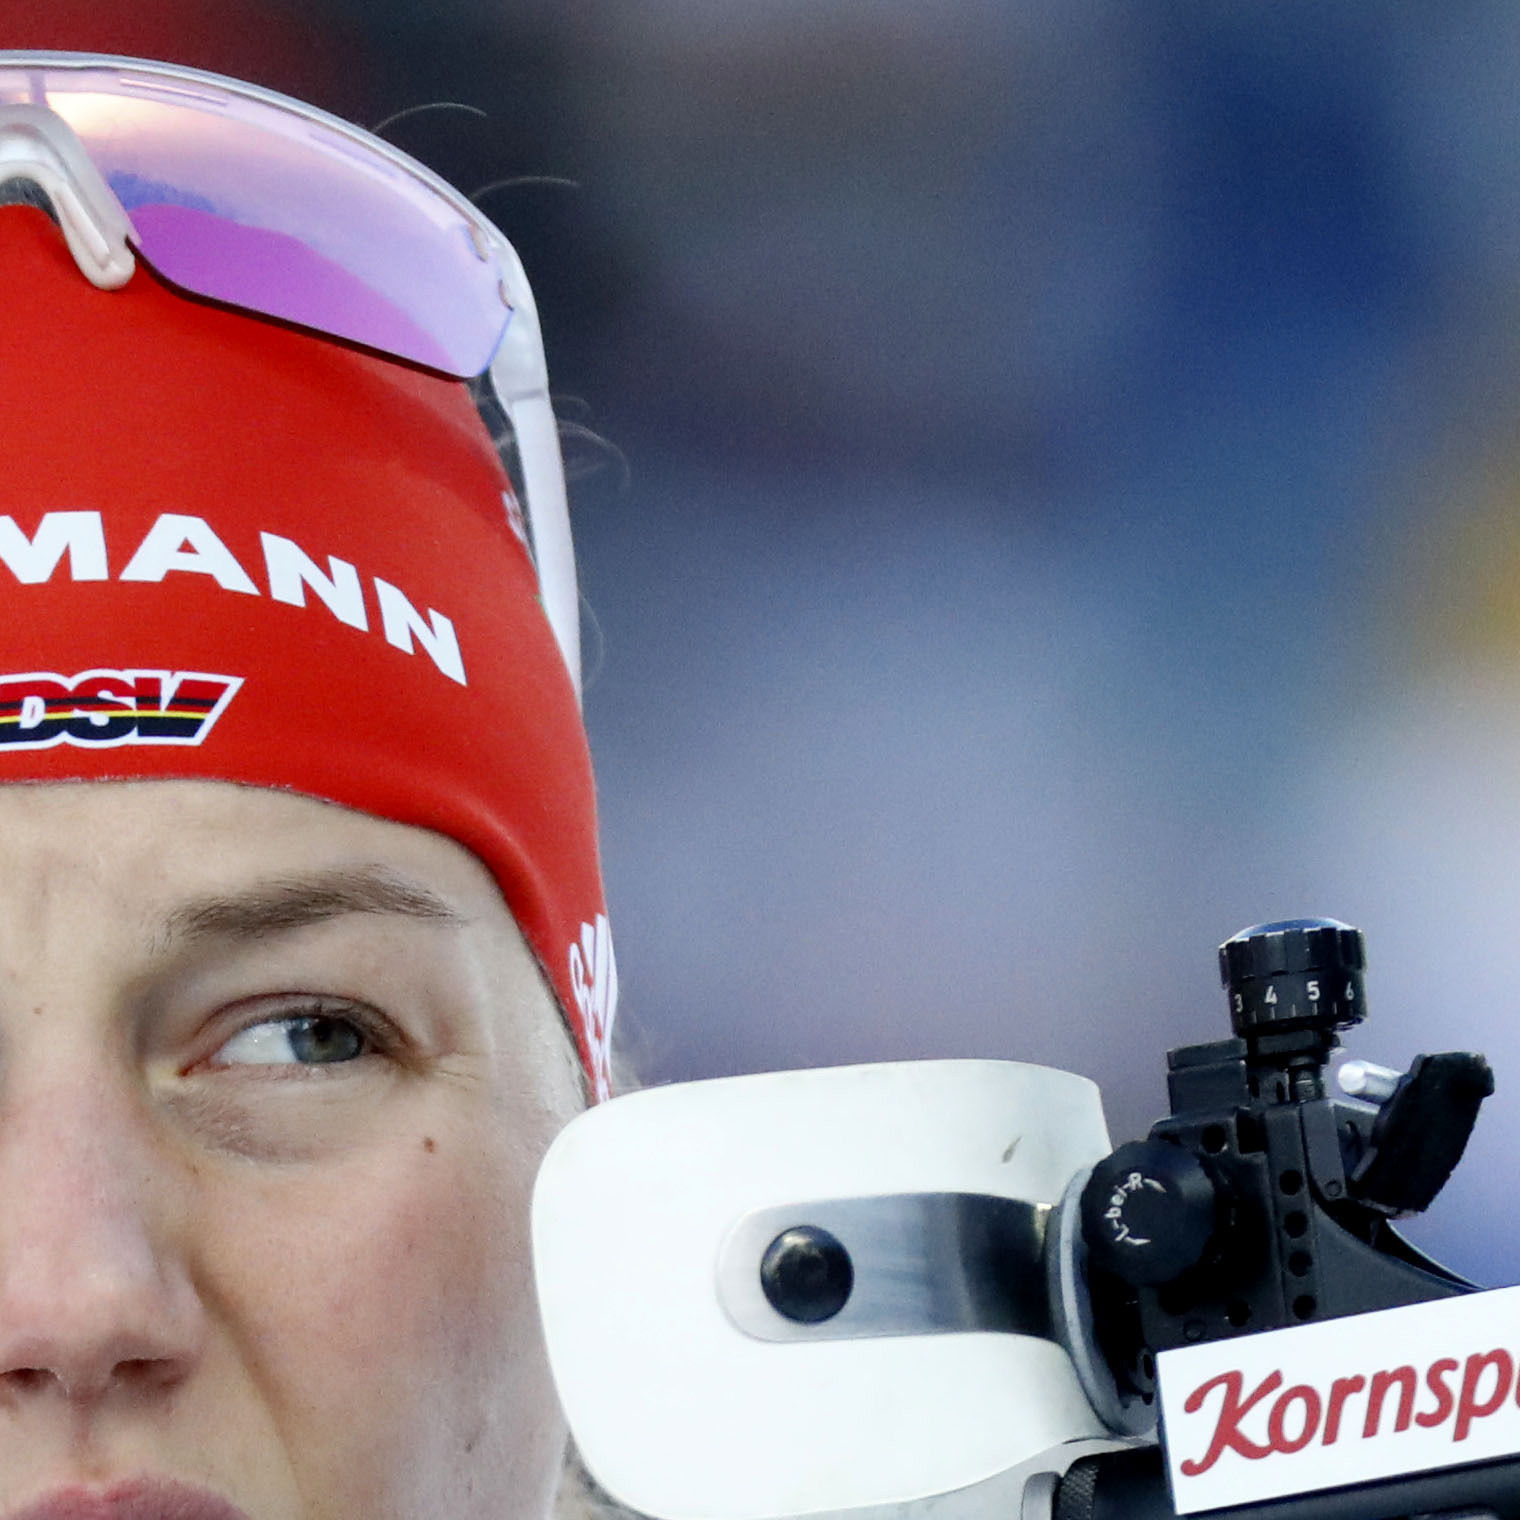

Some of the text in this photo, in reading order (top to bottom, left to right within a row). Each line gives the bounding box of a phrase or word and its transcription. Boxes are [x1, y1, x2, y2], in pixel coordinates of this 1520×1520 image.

[1264, 985, 1278, 1005] 4
[1306, 980, 1321, 1001] 5
[1345, 981, 1355, 1001] 6
